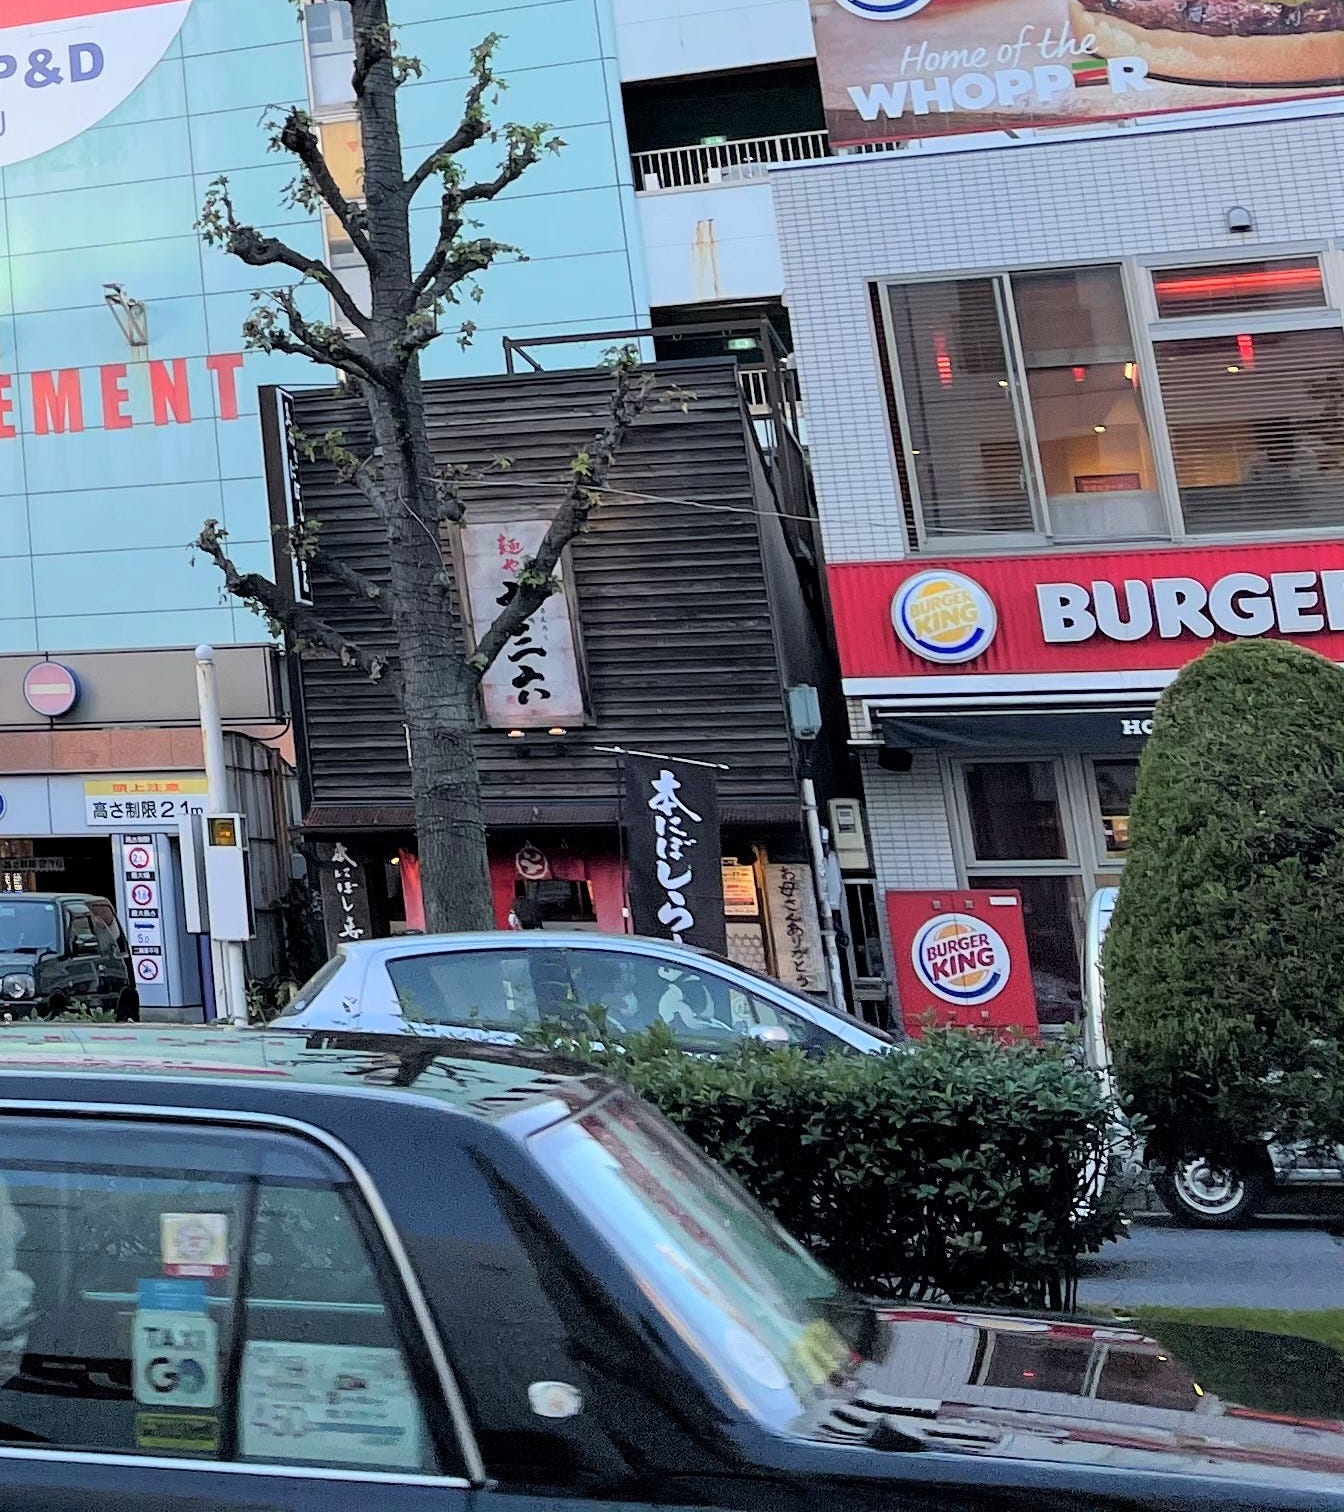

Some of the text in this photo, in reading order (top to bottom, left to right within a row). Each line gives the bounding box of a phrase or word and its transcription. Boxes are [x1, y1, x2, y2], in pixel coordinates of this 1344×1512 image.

[900, 21, 1097, 75] Home of the
[910, 590, 973, 620] BURGER
[914, 603, 980, 635] KING
[112, 783, 180, 793] 頭上注意
[648, 769, 703, 945] 本にぼしら
[925, 932, 990, 962] BURGER
[931, 948, 997, 981] KING
